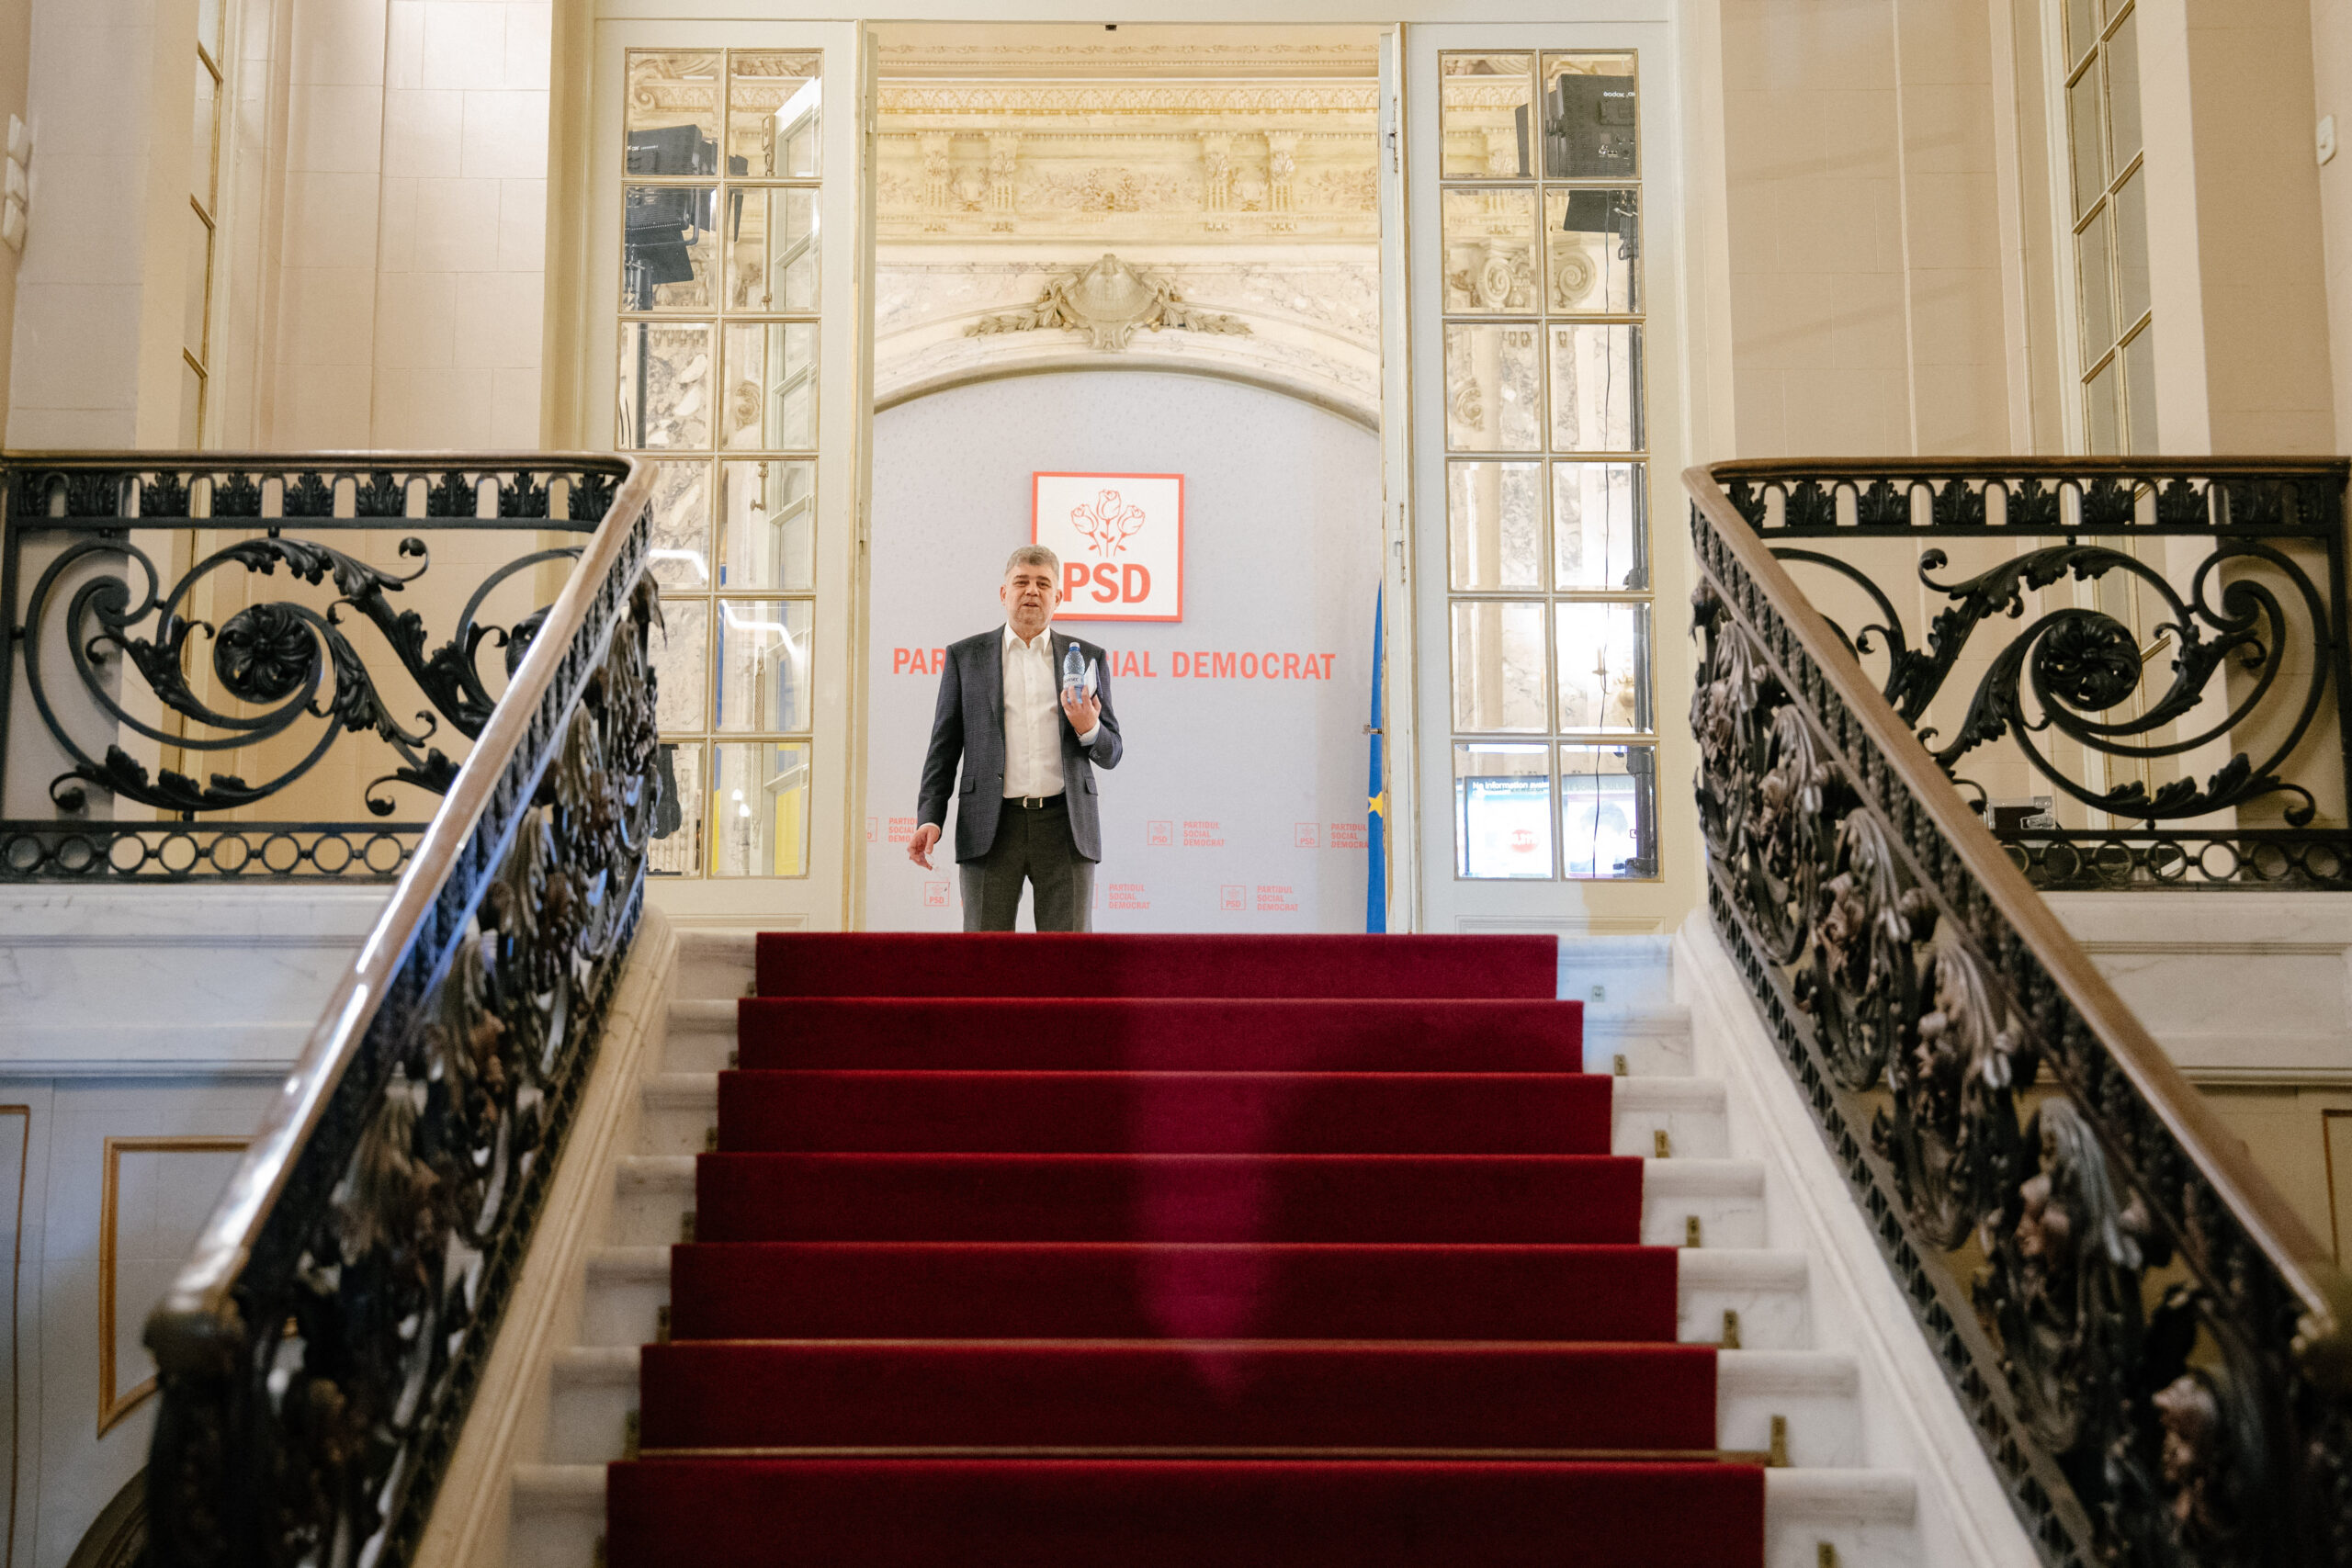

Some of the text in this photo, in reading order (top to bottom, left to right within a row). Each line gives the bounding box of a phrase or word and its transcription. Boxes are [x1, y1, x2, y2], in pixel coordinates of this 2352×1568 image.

[1063, 561, 1151, 604] PSD
[1106, 649, 1336, 681] IAL DEMOCRAT
[888, 817, 918, 826] PARTID
[1182, 820, 1220, 829] PARTIDUL
[888, 826, 915, 834] SOCIAL
[1330, 822, 1367, 831] PARTIDUL
[888, 834, 911, 842] DEMO
[1182, 829, 1211, 839] SOCIAL
[1330, 831, 1358, 840] SOCIAL
[1152, 835, 1168, 843] PSD
[1182, 838, 1225, 847] DEMOCRAT
[1300, 837, 1315, 845] PSD
[1330, 840, 1369, 849] DEMOCRA
[1108, 883, 1146, 892] PARTIDUL
[1256, 885, 1294, 894] PARTIDUL
[929, 896, 944, 905] PSD
[1108, 892, 1136, 901] SOCIAL
[1256, 894, 1284, 903] SOCIAL
[1108, 900, 1150, 910] DEMOCRAT
[1226, 899, 1241, 908] PSD
[1256, 902, 1298, 912] DEMOCRAT
